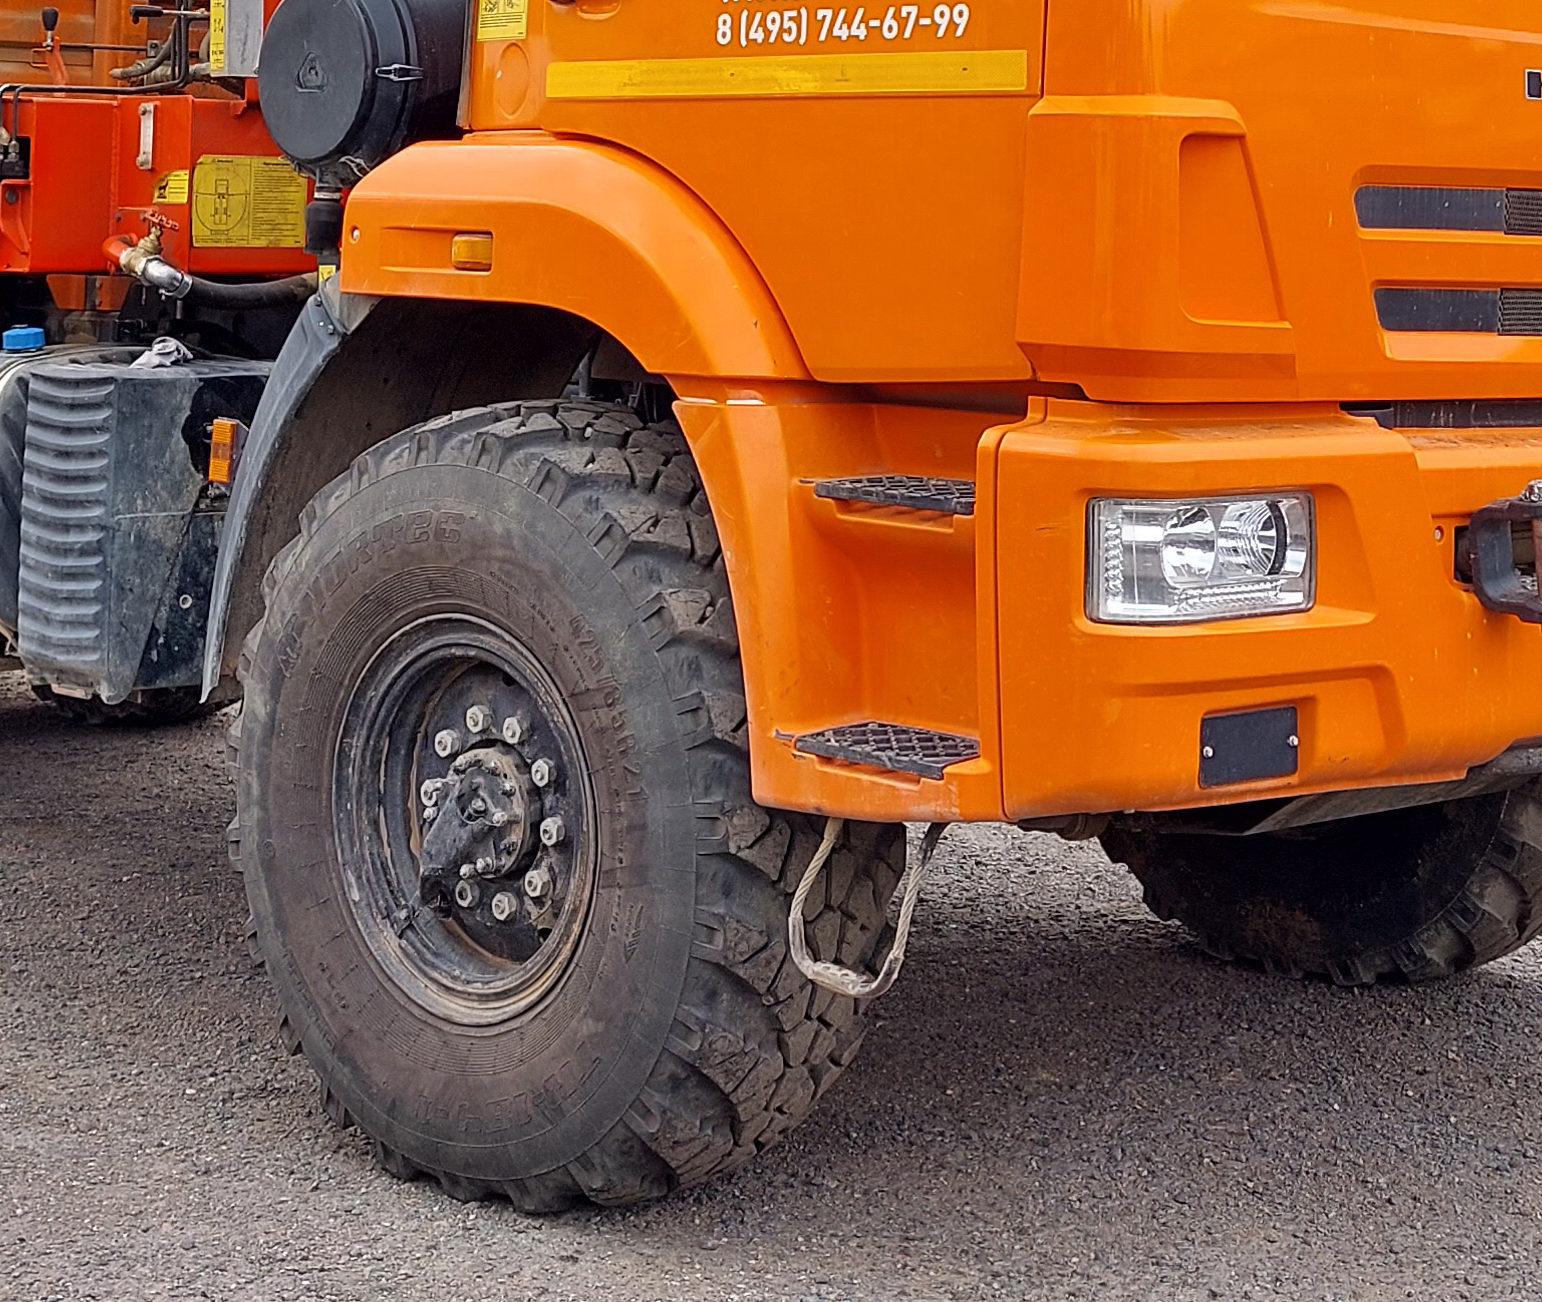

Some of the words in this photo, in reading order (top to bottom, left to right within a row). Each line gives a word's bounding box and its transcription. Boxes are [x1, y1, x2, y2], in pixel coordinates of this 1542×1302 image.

[716, 13, 732, 45] 8
[740, 6, 808, 47] (495)
[816, 3, 970, 42] 744-67-99
